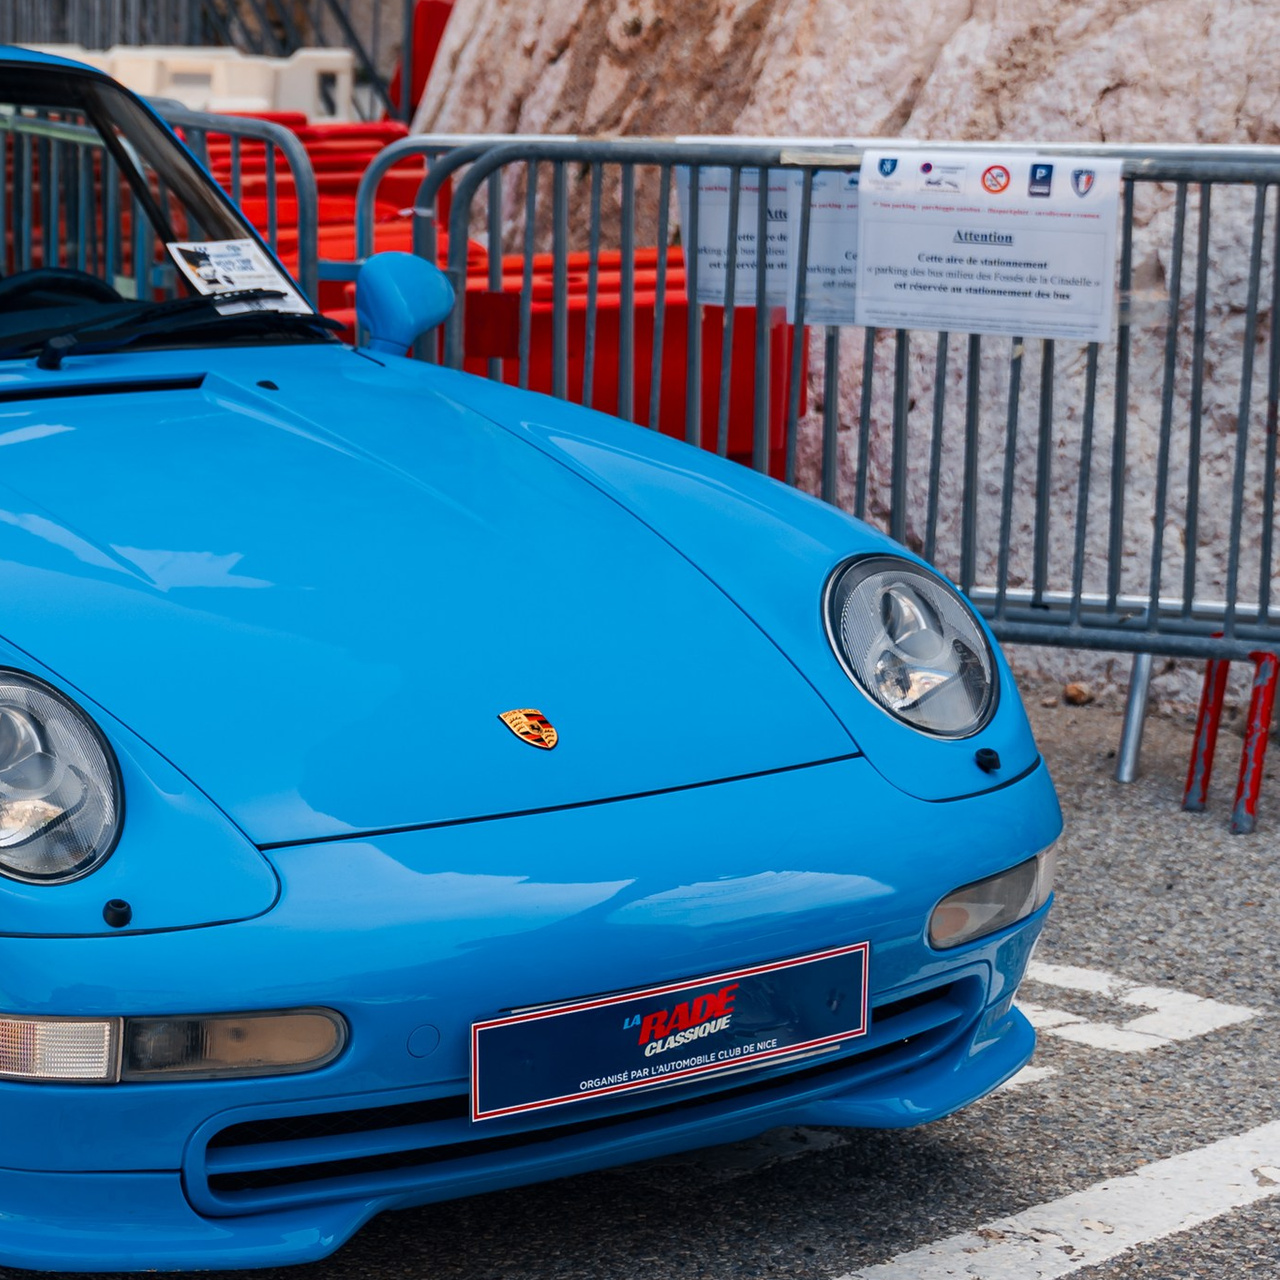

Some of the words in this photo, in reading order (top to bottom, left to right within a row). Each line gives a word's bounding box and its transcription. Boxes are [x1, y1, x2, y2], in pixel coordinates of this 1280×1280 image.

[953, 229, 1013, 245] Attention
[918, 253, 942, 263] Cette
[945, 255, 963, 265] aire
[966, 256, 977, 265] de
[980, 258, 1048, 269] stationnement
[874, 265, 908, 277] parking
[910, 266, 924, 276] des
[927, 267, 943, 277] bus
[976, 270, 991, 280] des
[1026, 274, 1037, 284] de
[894, 282, 906, 290] est
[909, 281, 948, 293] réservée
[951, 285, 962, 293] au
[965, 285, 1031, 297] stationnement
[1034, 289, 1050, 299] des
[1053, 289, 1071, 300] bus
[623, 1014, 640, 1030] LA
[638, 983, 739, 1045] RADE
[644, 1014, 732, 1057] CLASSIQUE
[580, 1071, 629, 1090] ORGANISÉ
[630, 1068, 649, 1080] PAR
[651, 1053, 716, 1075] L'AUTOMOBILE
[718, 1047, 742, 1060] CLUB
[743, 1044, 755, 1054] DE
[757, 1038, 777, 1050] NICE
